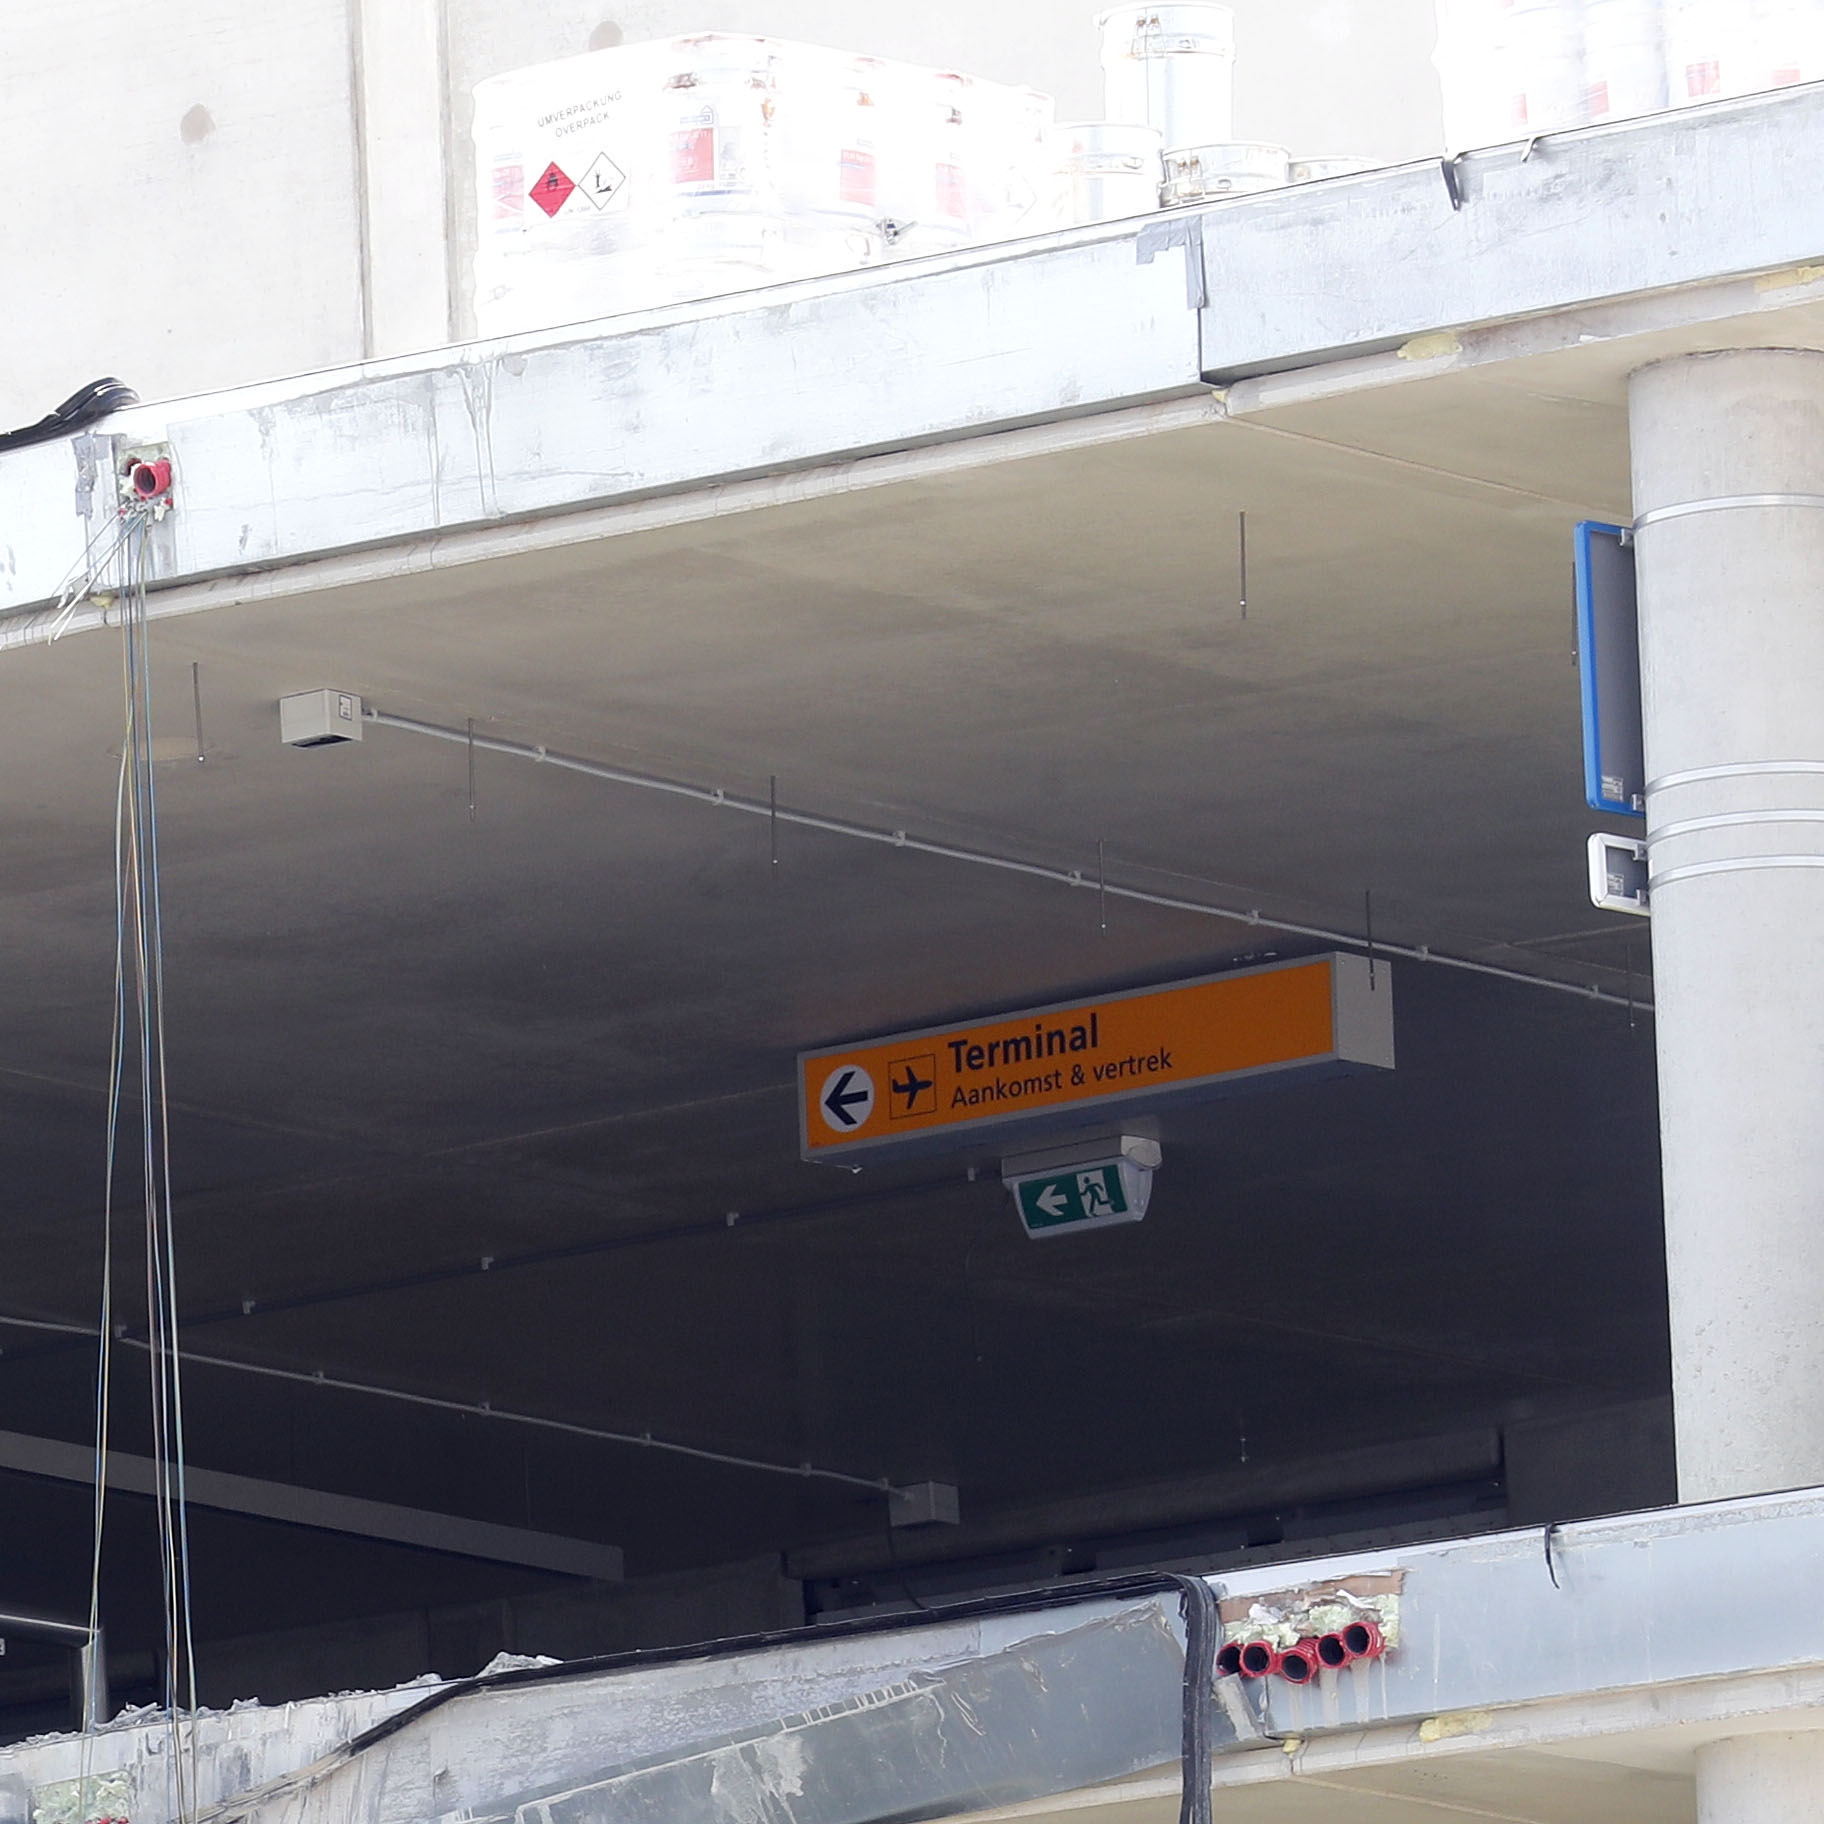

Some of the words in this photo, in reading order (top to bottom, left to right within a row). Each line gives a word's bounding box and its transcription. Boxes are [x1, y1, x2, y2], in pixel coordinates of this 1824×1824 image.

[537, 90, 622, 128] UMVERPACKUNG
[555, 111, 610, 138] OVERPACK
[948, 1013, 1097, 1072] Terminal
[952, 1070, 1062, 1108] Aankomst
[1071, 1064, 1085, 1086] &
[1093, 1048, 1172, 1081] vertrek
